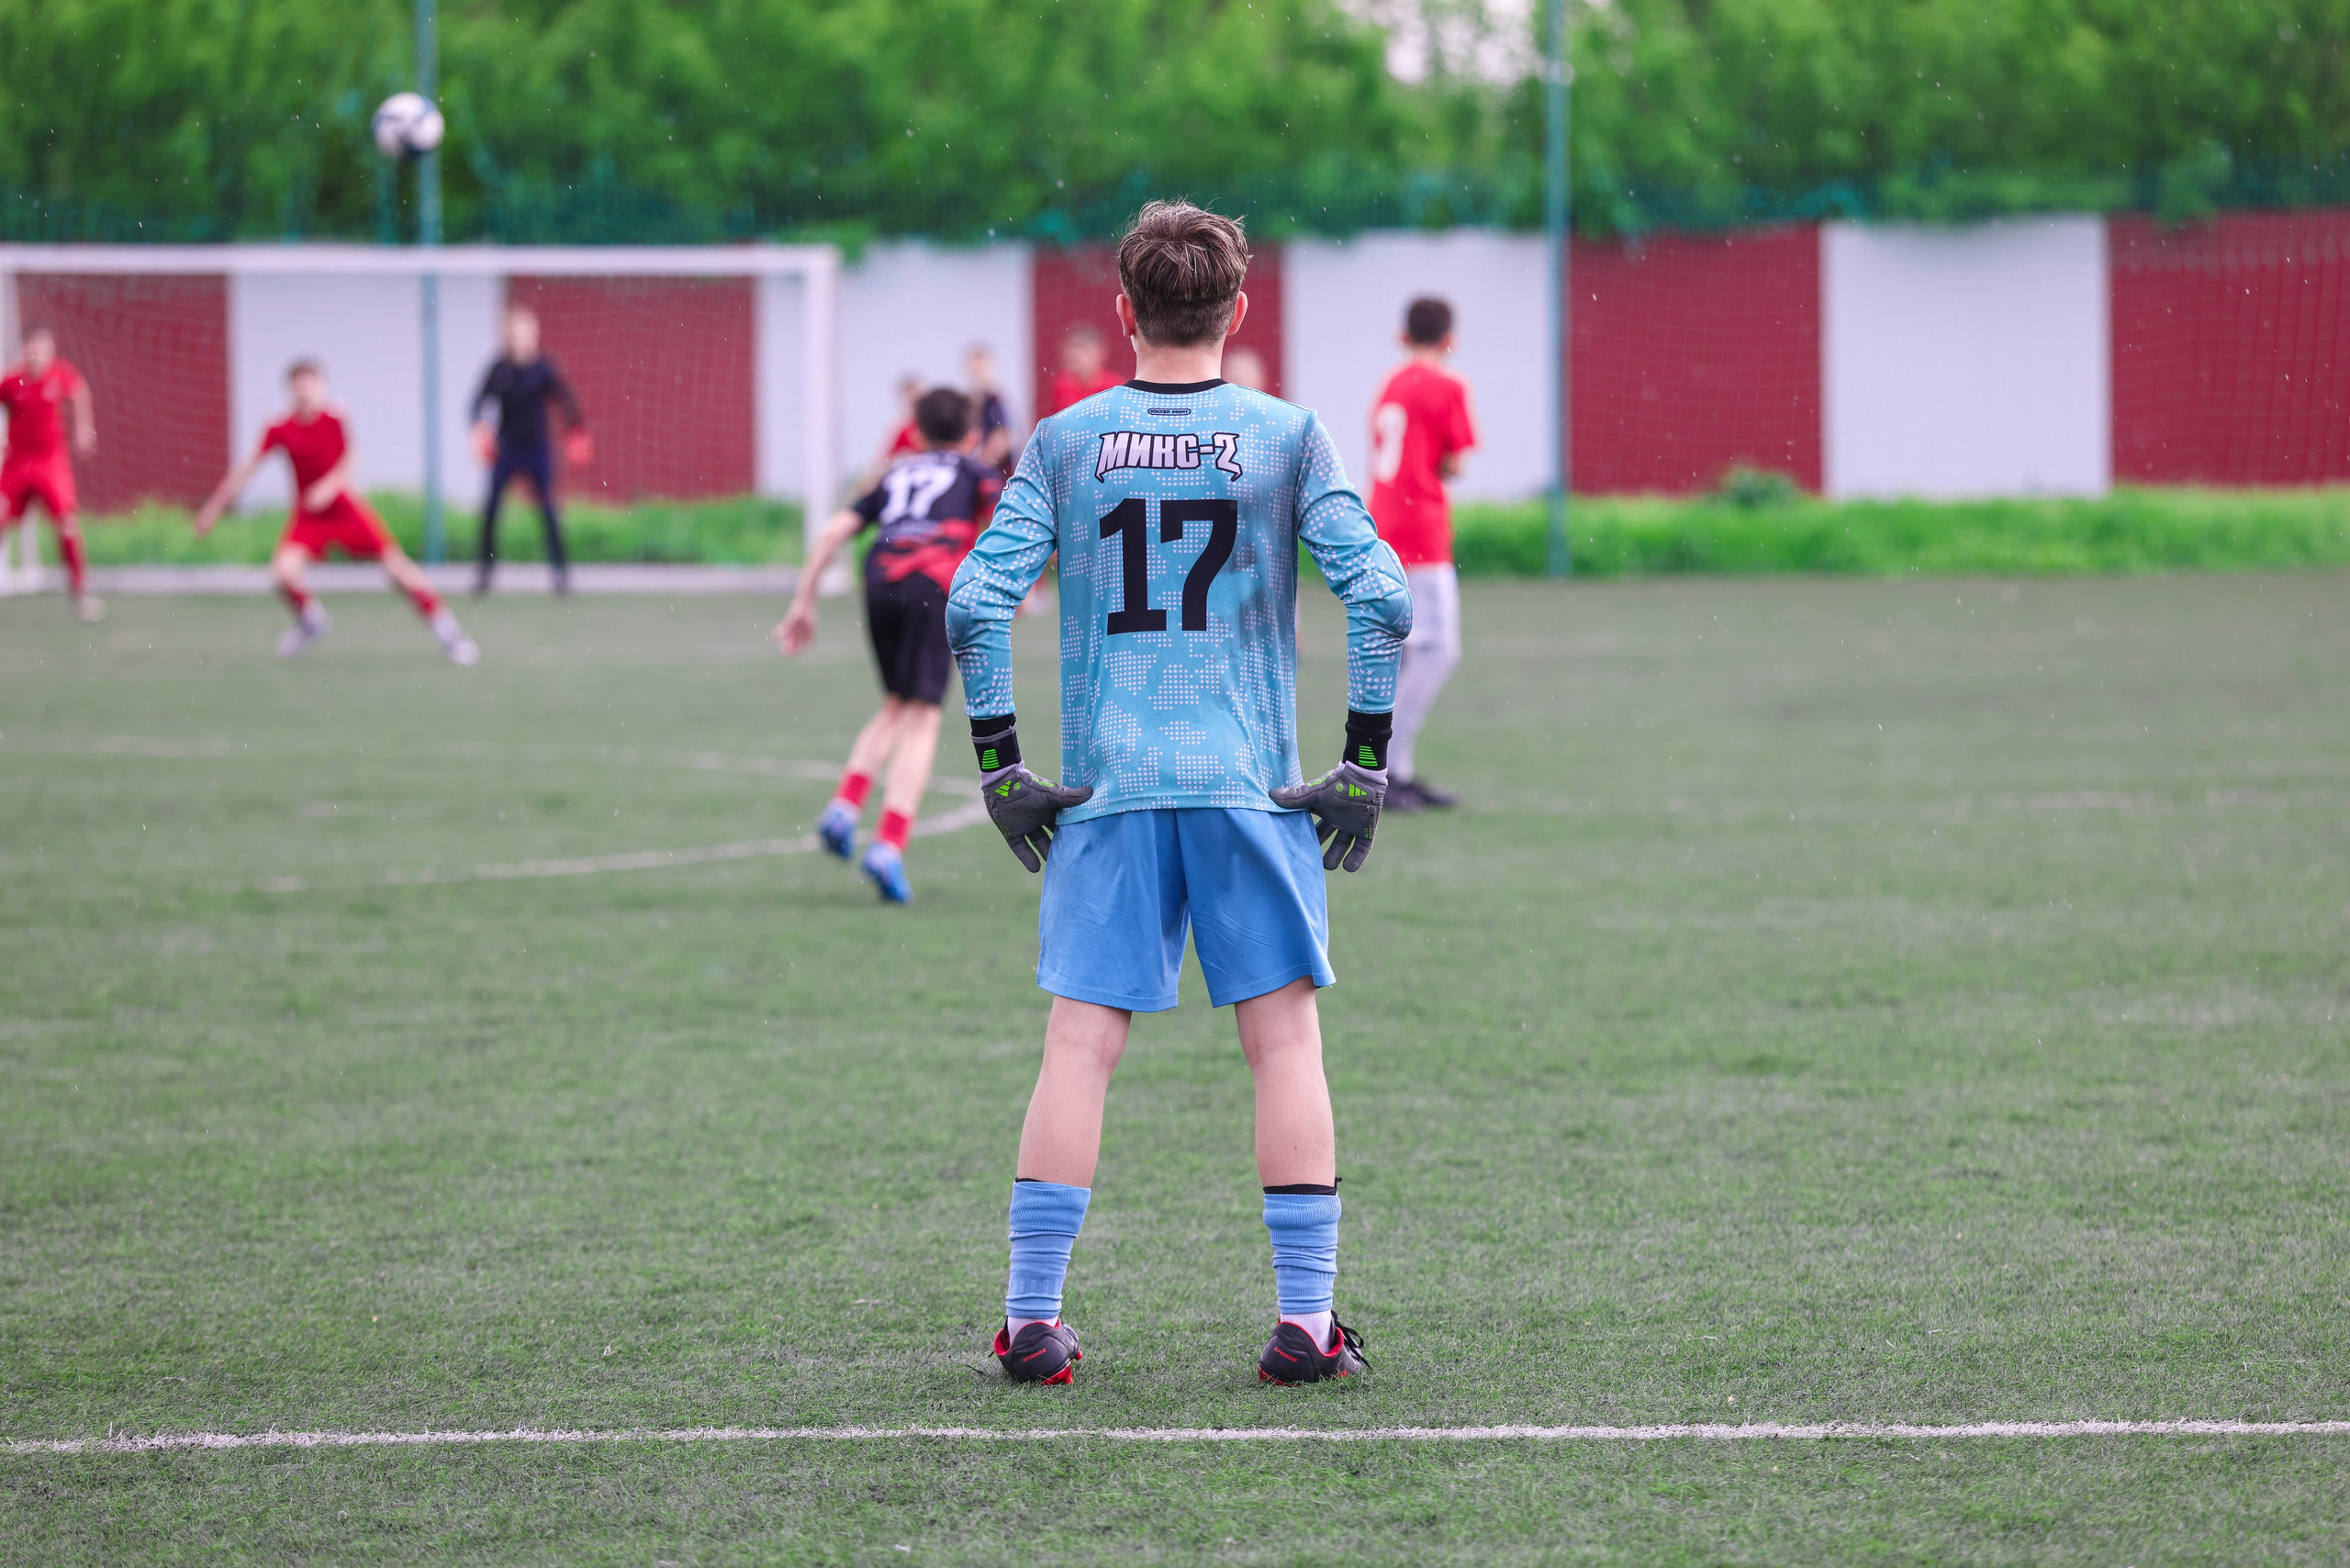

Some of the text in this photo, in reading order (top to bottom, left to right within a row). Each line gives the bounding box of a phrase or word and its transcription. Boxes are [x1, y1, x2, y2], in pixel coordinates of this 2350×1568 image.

[1095, 431, 1243, 483] МИКС-2
[878, 465, 957, 524] 17
[1099, 498, 1238, 635] 17
[1023, 1347, 1046, 1362] kronos
[1273, 1346, 1298, 1362] kronos
